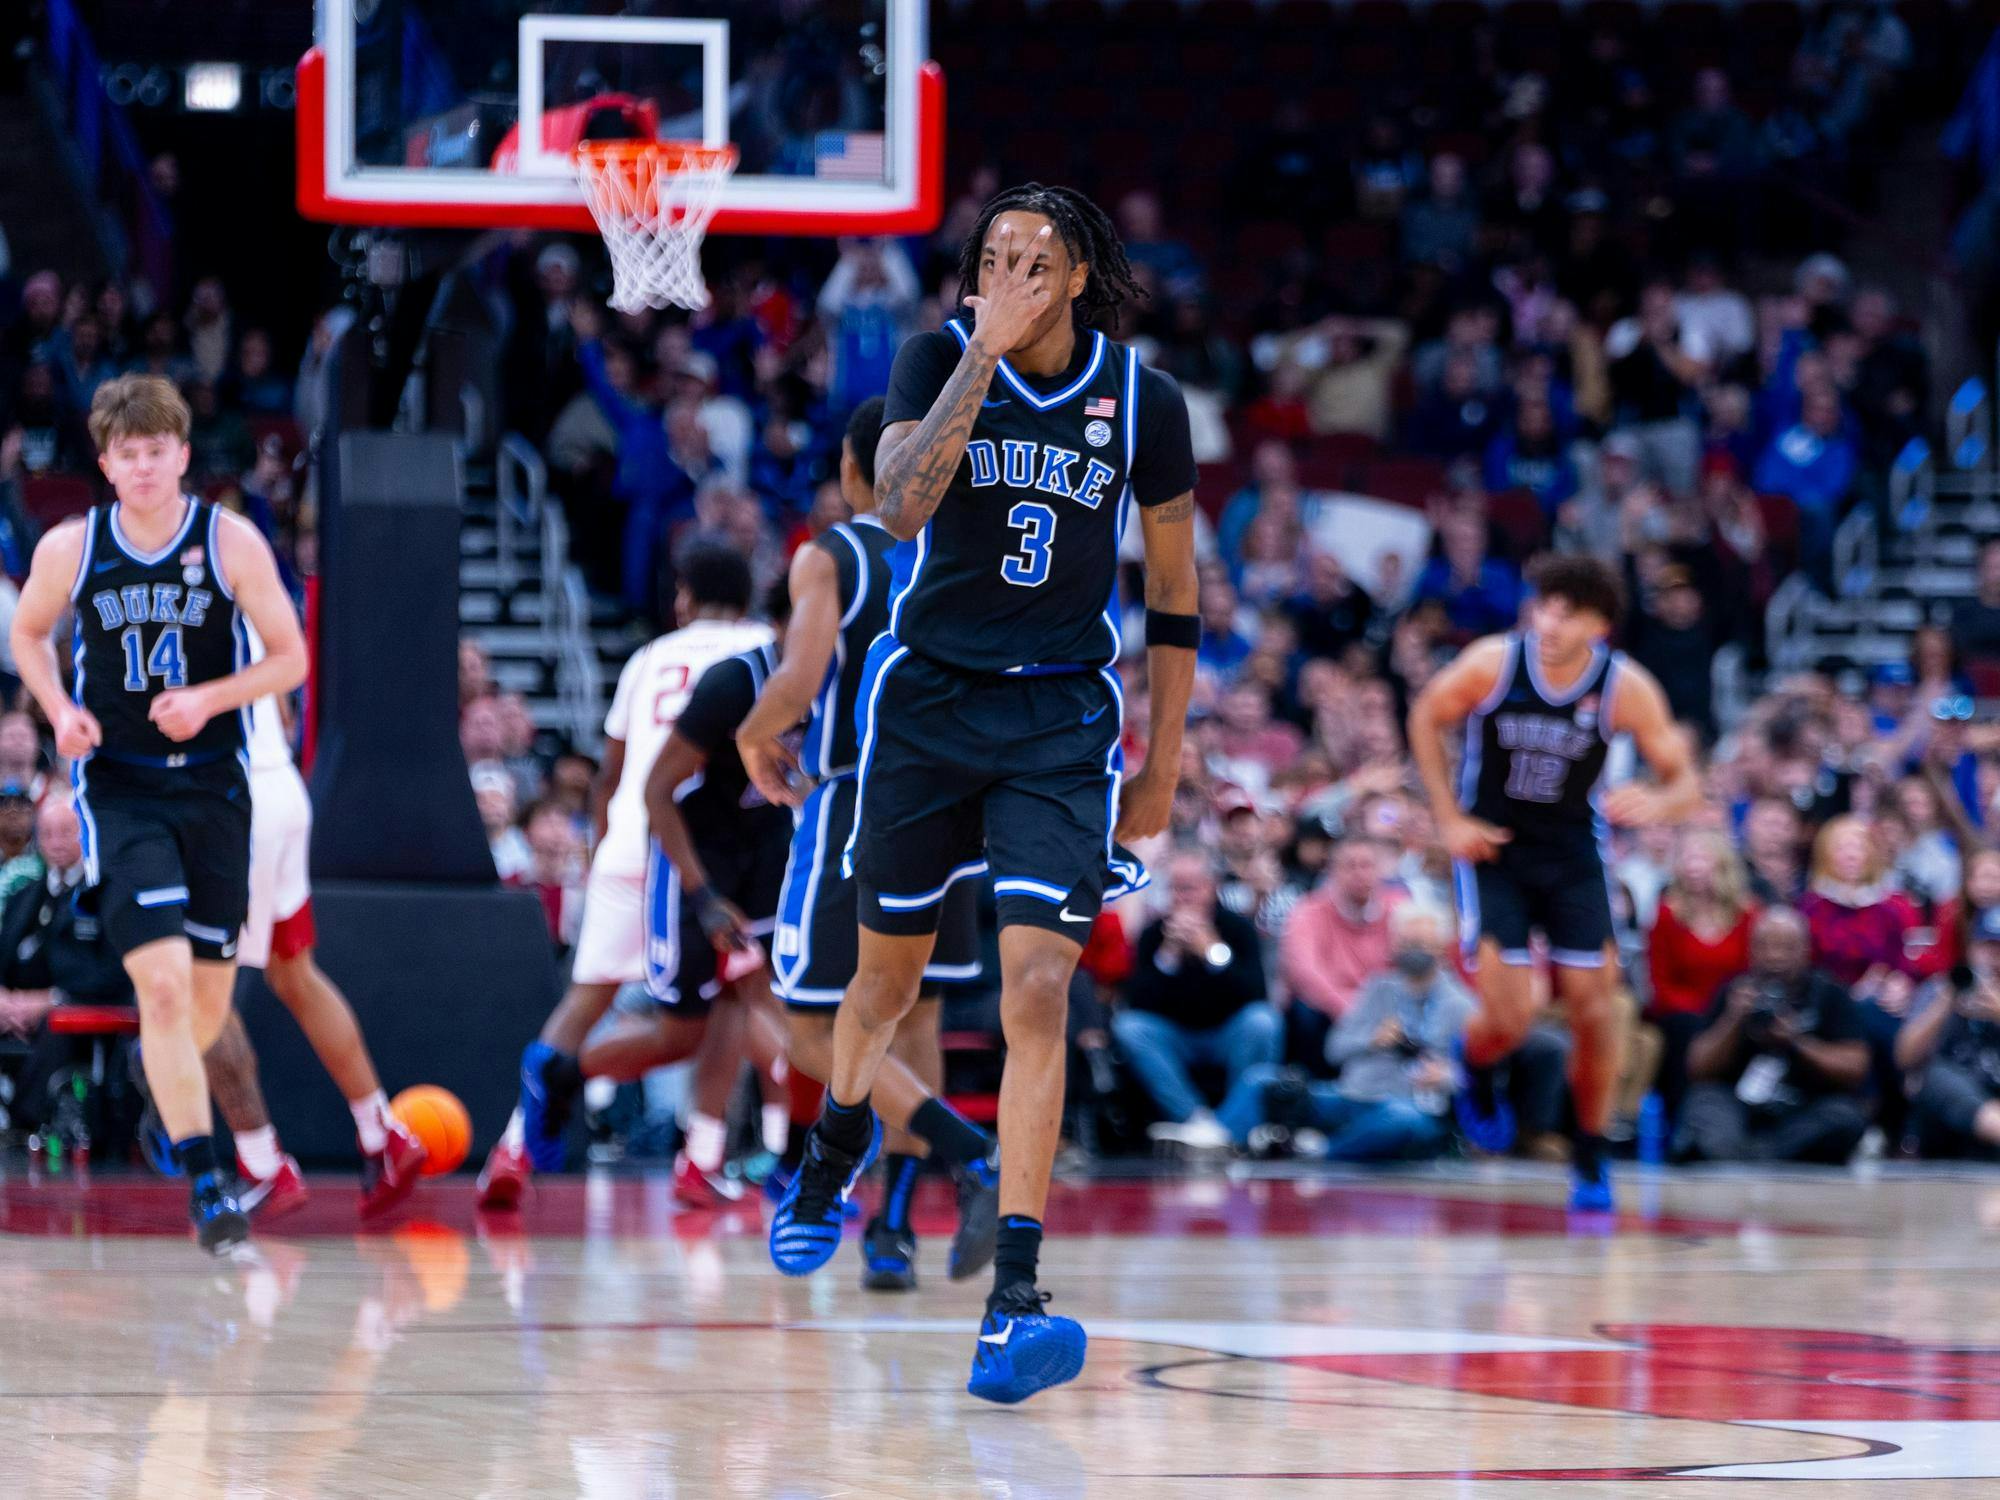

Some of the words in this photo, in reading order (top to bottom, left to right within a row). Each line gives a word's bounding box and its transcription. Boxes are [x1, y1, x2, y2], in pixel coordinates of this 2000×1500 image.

[966, 439, 1116, 510] DUKE
[1000, 501, 1057, 587] 3
[93, 583, 213, 631] DUKE
[121, 624, 188, 691] 14
[1504, 751, 1570, 803] 12
